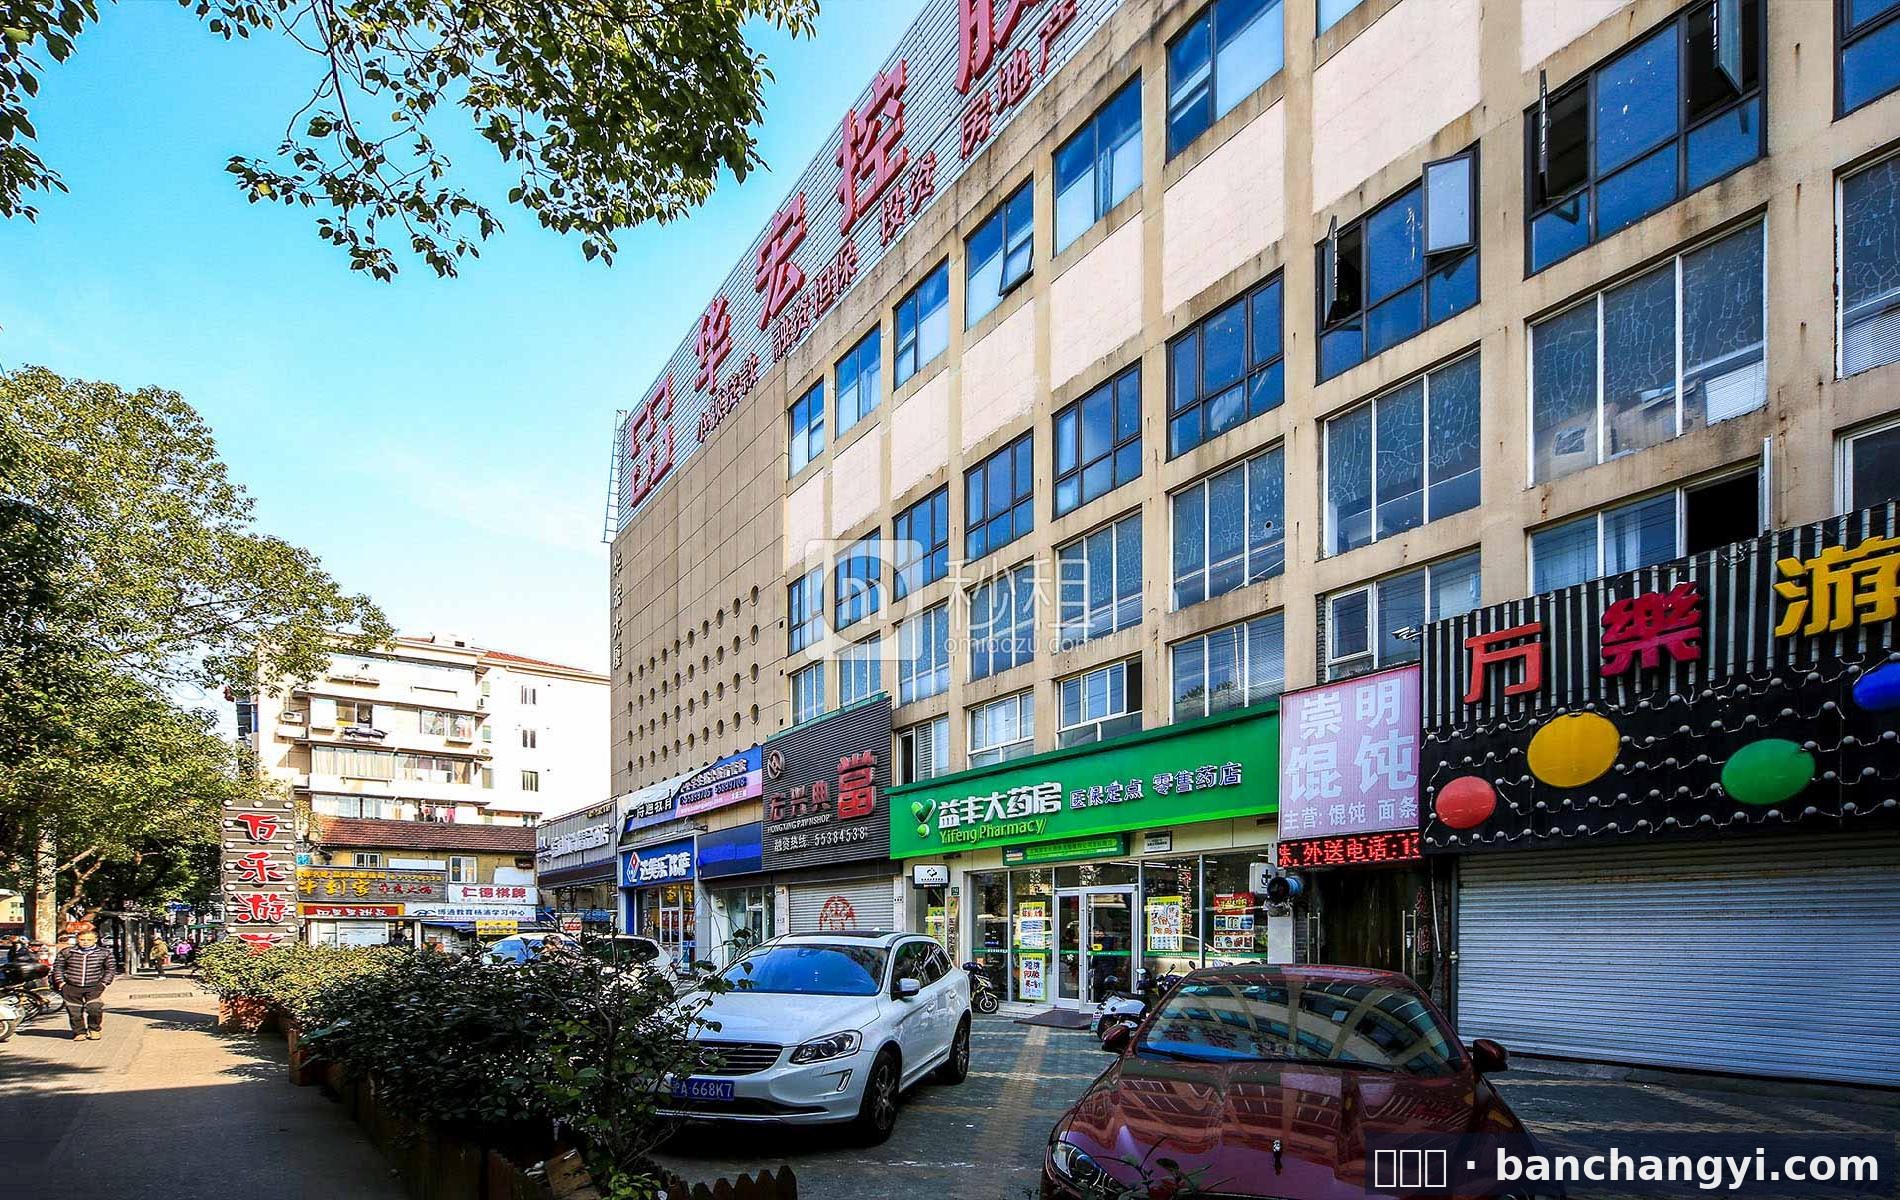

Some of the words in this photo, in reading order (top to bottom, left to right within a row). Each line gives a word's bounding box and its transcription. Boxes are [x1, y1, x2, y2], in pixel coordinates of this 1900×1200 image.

[772, 240, 859, 362] 融资担保
[880, 150, 937, 247] 投资
[960, 0, 1078, 160] 房地产
[1299, 677, 1403, 741] 崇明
[938, 782, 1062, 829] 益丰大药房
[1069, 778, 1144, 810] 医保定点
[1152, 761, 1242, 796] 零售药店
[1285, 728, 1418, 803] 馄饨
[814, 826, 867, 847] 55384538
[979, 818, 1047, 839] Pharmacy
[1328, 801, 1367, 827] 馄饨
[1377, 796, 1419, 823] 面条
